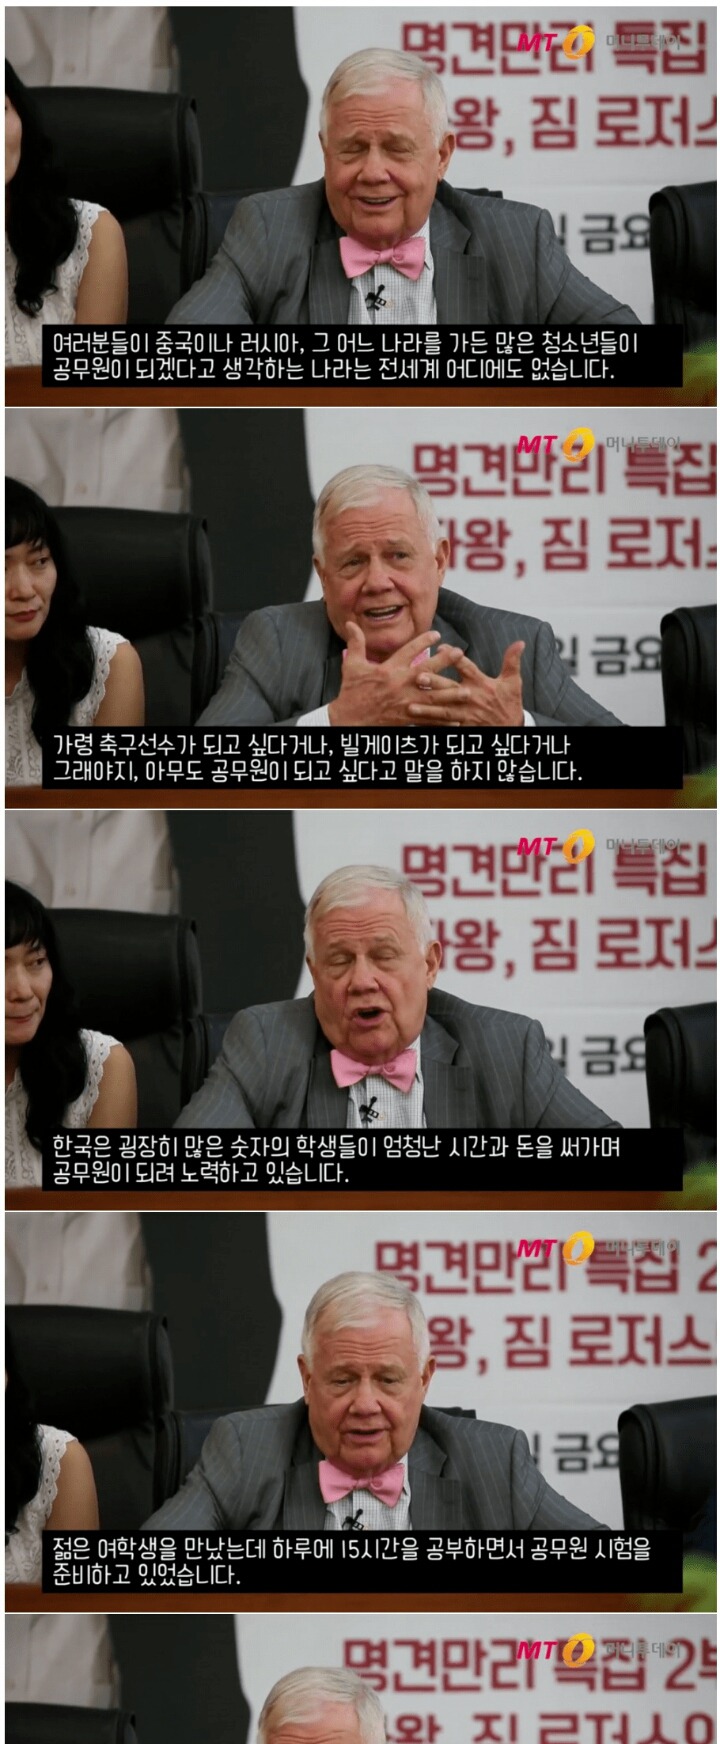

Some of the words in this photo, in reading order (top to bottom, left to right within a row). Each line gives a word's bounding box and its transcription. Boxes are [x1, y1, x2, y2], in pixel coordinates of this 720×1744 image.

[402, 22, 594, 75] 명견만리
[614, 22, 707, 75] 특집
[531, 96, 577, 149] 짐
[543, 518, 589, 572] 짐
[402, 844, 594, 898] 명견만리
[613, 844, 707, 898] 특집
[532, 918, 578, 972] 짐
[375, 1240, 567, 1295] 명견만리
[506, 1315, 550, 1370] 짐
[343, 1637, 535, 1692] 명견만리
